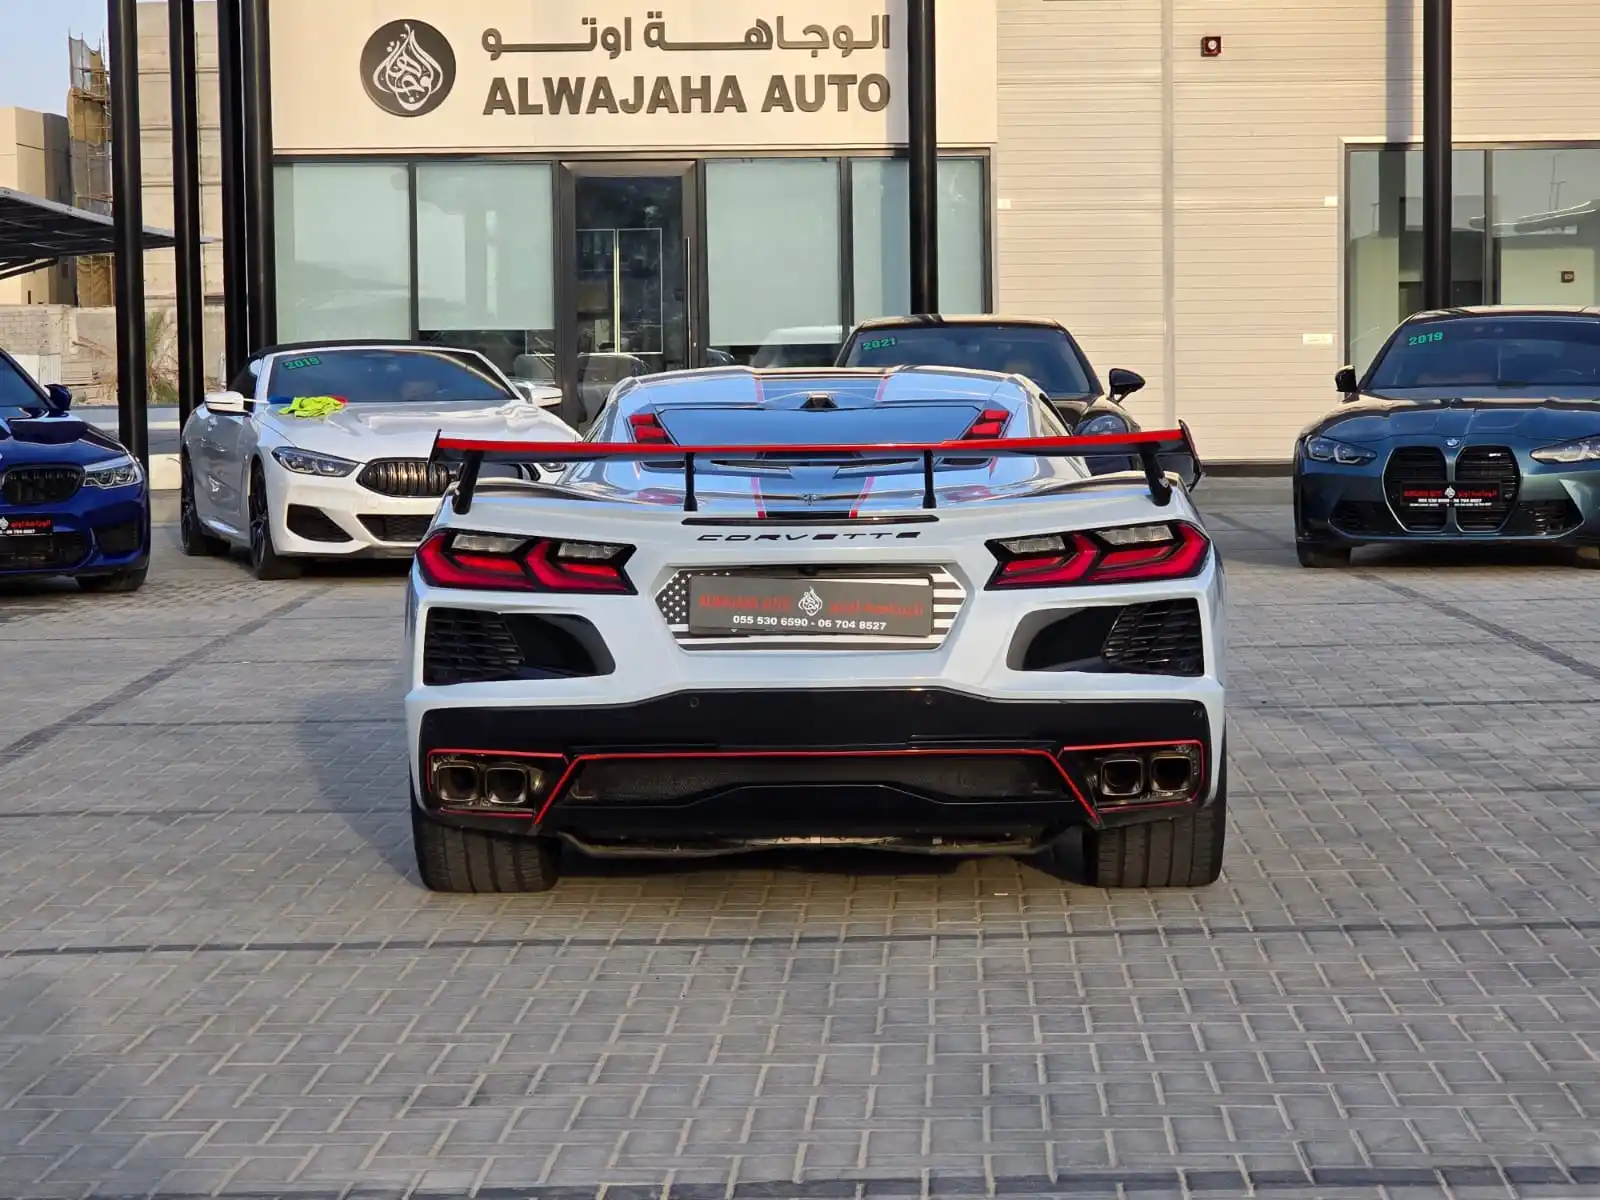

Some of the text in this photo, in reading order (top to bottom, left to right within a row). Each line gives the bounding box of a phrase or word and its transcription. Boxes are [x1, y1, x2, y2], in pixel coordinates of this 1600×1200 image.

[643, 10, 890, 58] الوجاهة
[482, 73, 891, 116] ALWAJAHA AUTO
[862, 338, 896, 350] 2021
[1408, 331, 1444, 346] 2019
[697, 531, 921, 542] CORVETTE
[732, 615, 754, 624] 055
[756, 616, 778, 625] 530
[780, 617, 808, 626] 6590
[818, 619, 832, 628] 06
[835, 619, 857, 629] 704
[858, 621, 887, 631] 8527
